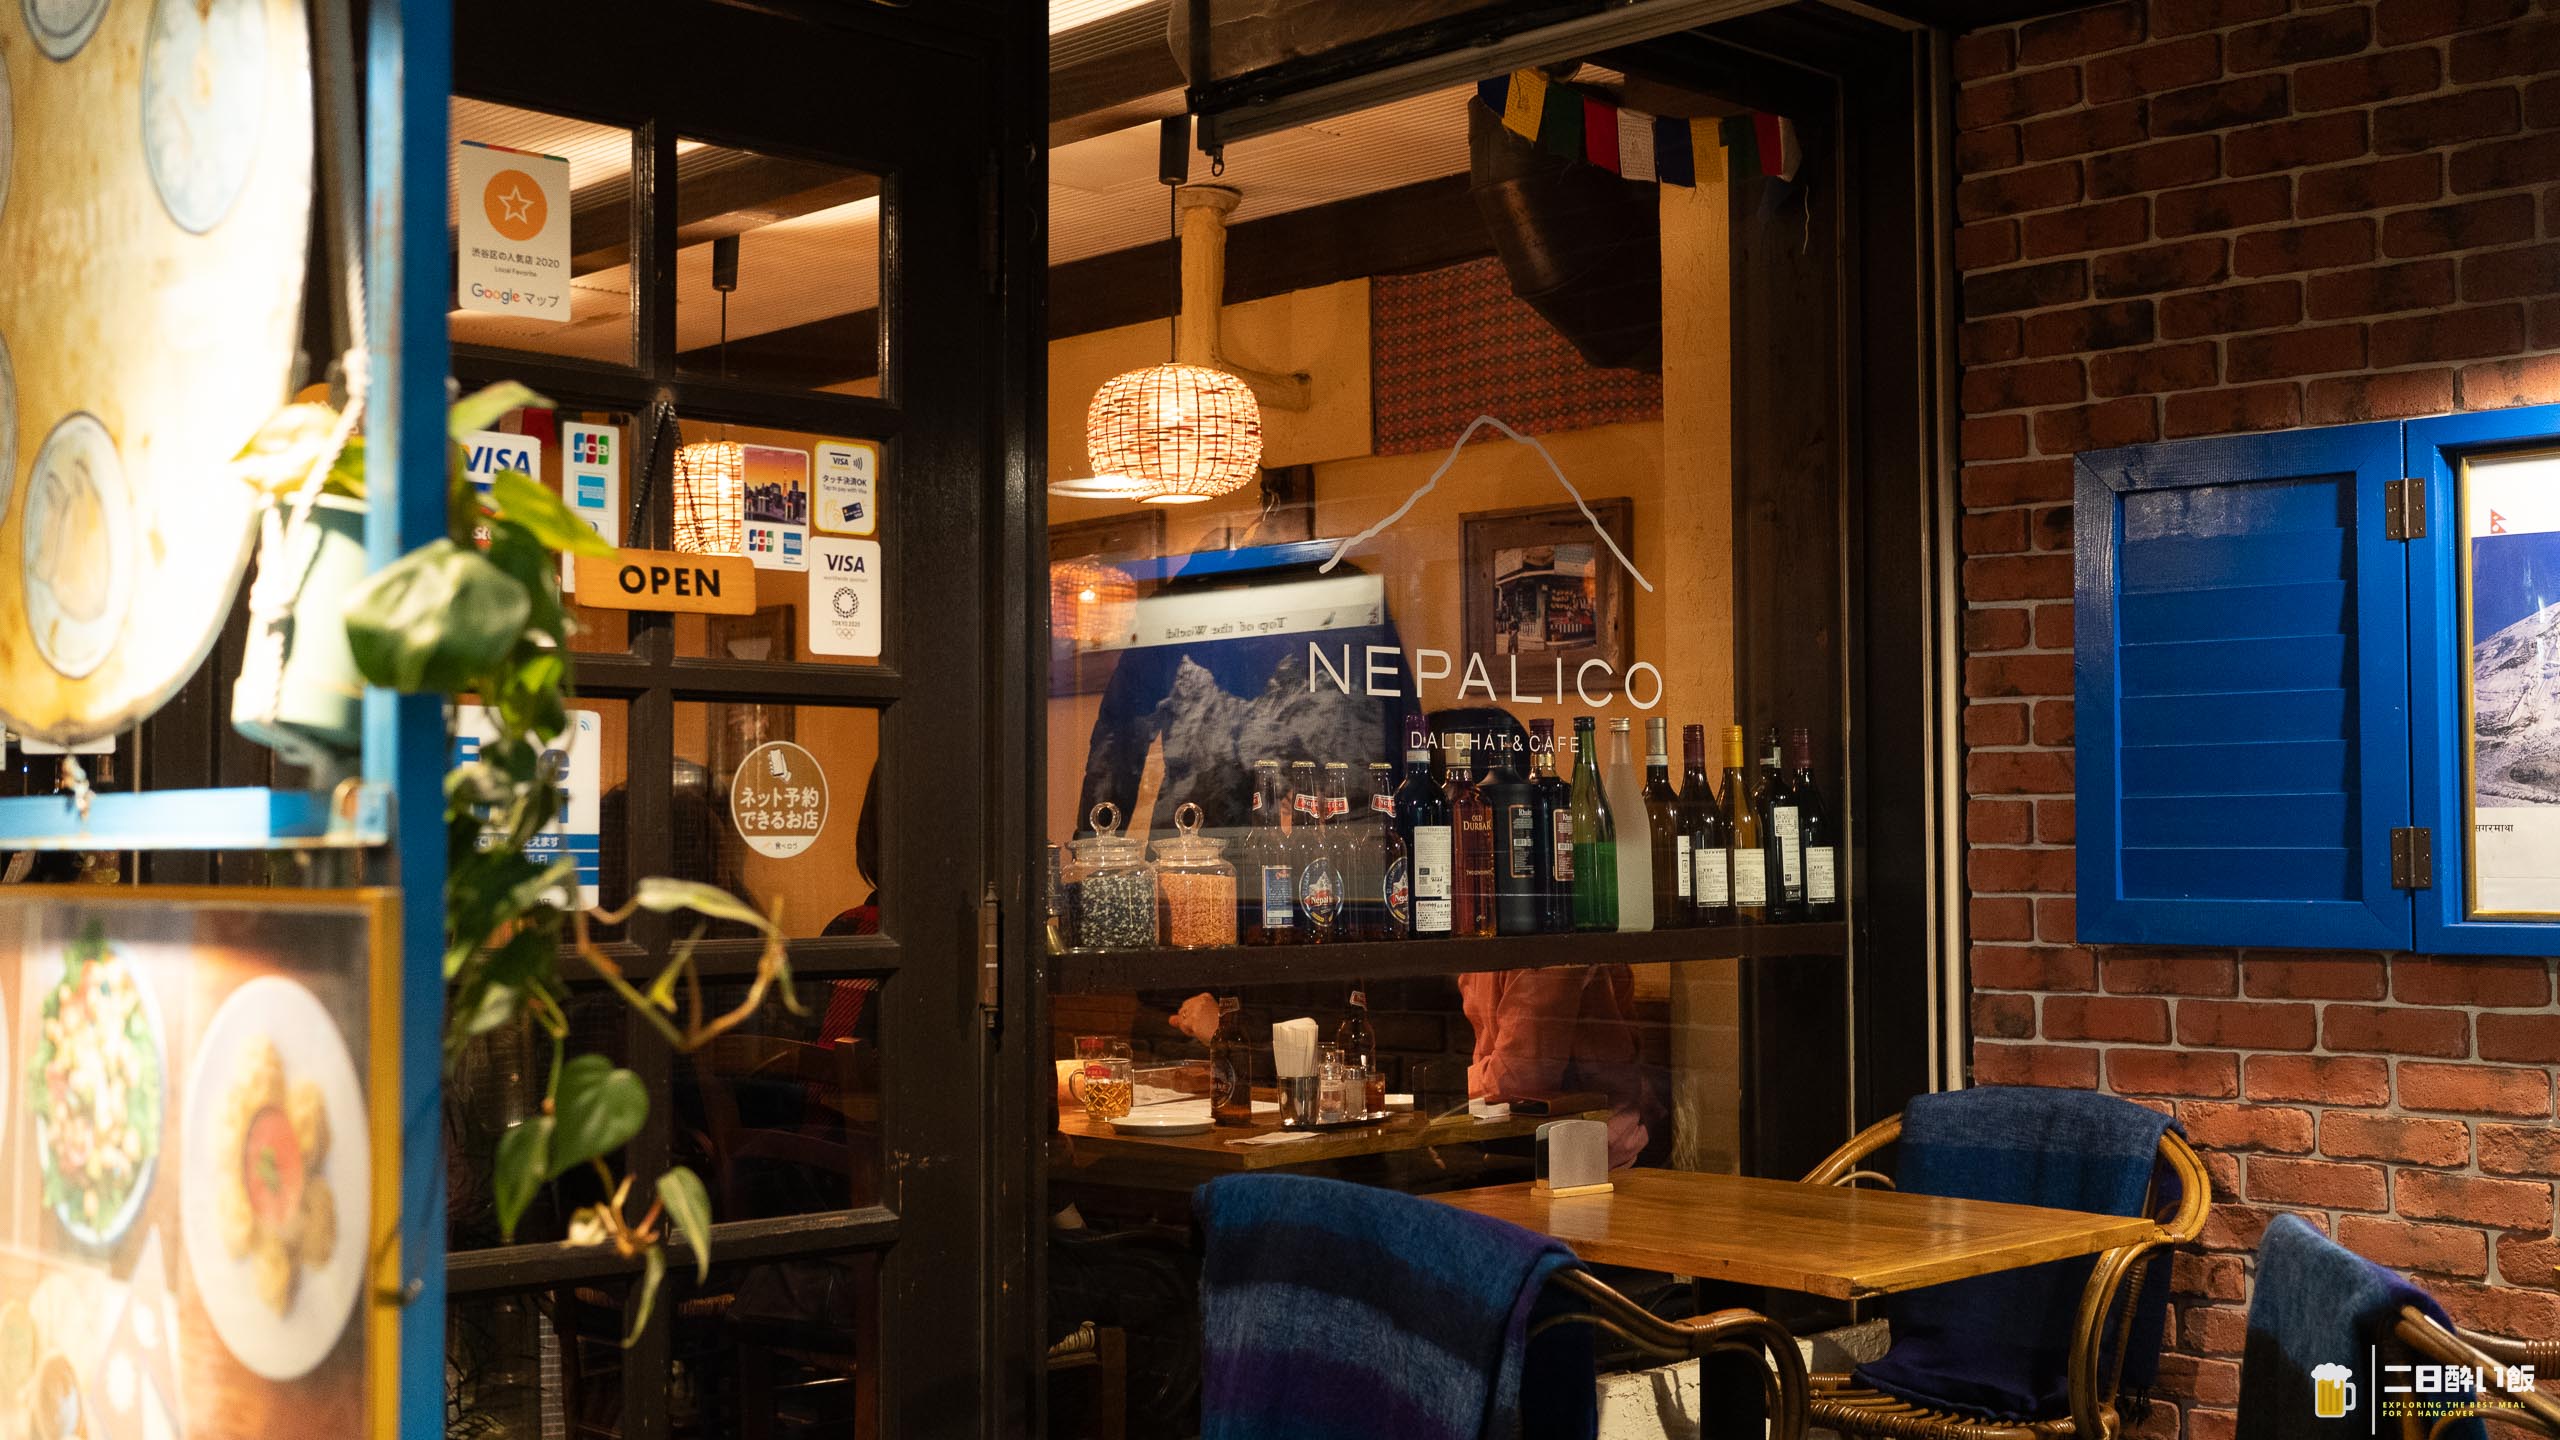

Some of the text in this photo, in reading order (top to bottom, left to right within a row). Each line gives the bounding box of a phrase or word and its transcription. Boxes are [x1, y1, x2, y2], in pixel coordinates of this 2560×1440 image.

[472, 247, 560, 269] 渋谷区の人気店 2020
[471, 282, 560, 308] Google マップ
[464, 446, 531, 478] VISA
[832, 457, 849, 466] VISA
[824, 553, 865, 573] VISA
[619, 565, 721, 597] OPEN
[1309, 641, 1663, 710] NEPALICO
[740, 786, 819, 809] ネット予約
[740, 809, 819, 830] できるお店
[1463, 819, 1491, 831] DURBAR
